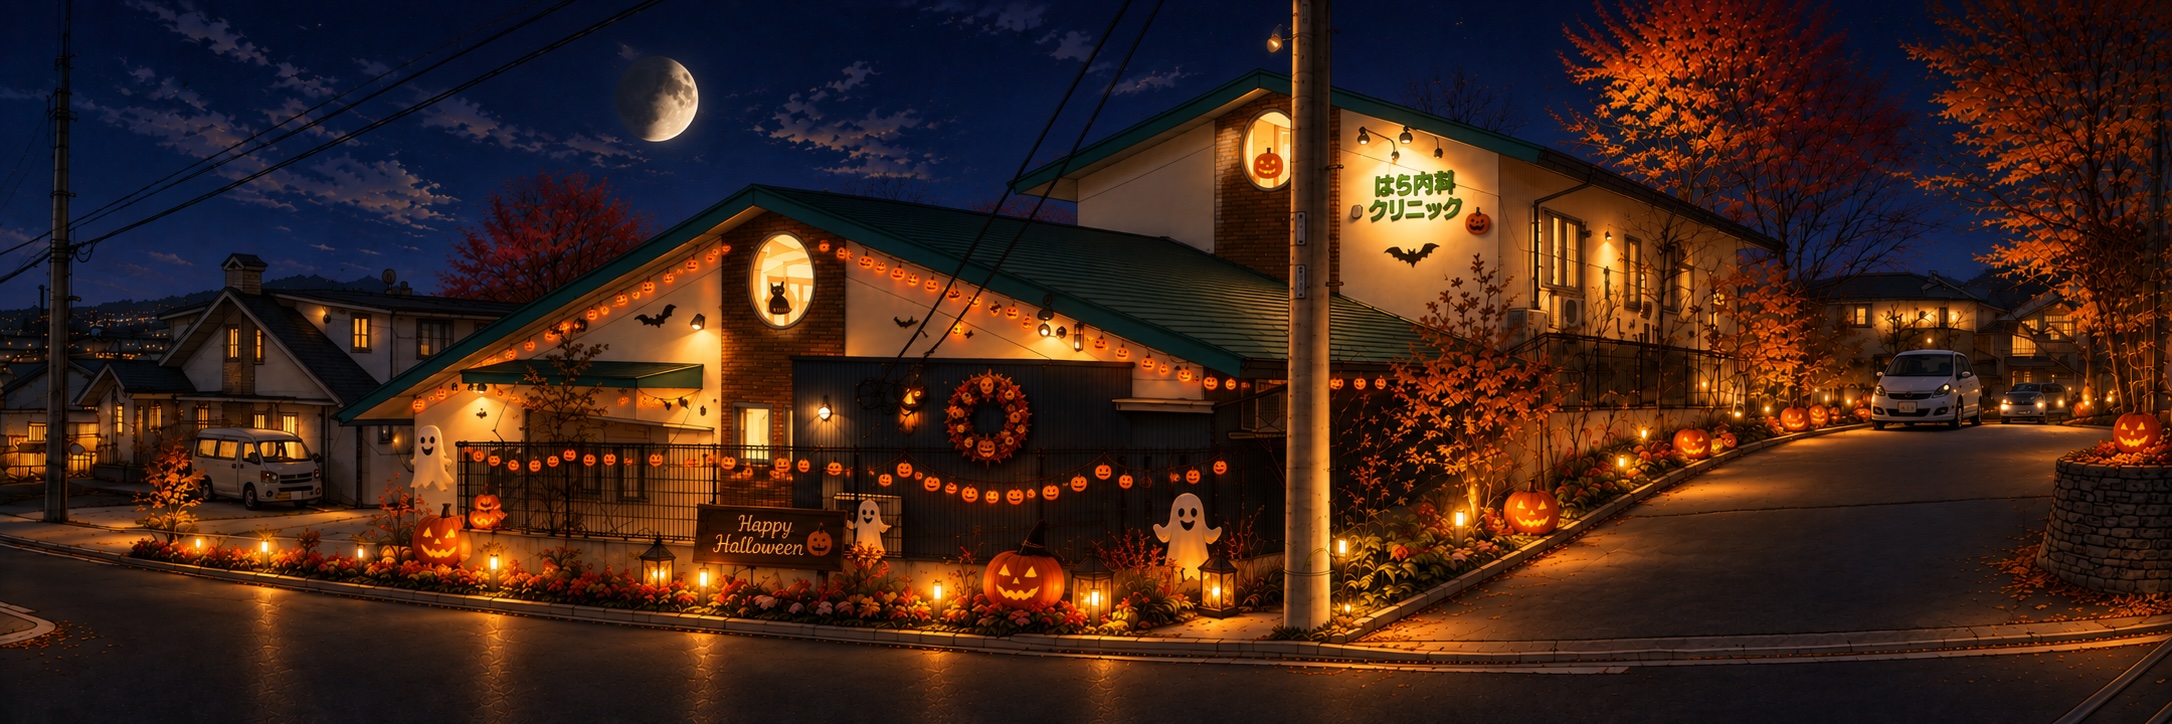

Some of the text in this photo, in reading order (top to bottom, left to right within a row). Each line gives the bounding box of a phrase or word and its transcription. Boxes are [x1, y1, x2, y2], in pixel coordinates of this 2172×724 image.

[1375, 170, 1456, 198] はら内科
[1369, 197, 1463, 223] クリニック
[738, 514, 793, 540] Happy
[712, 533, 805, 557] Halloween
